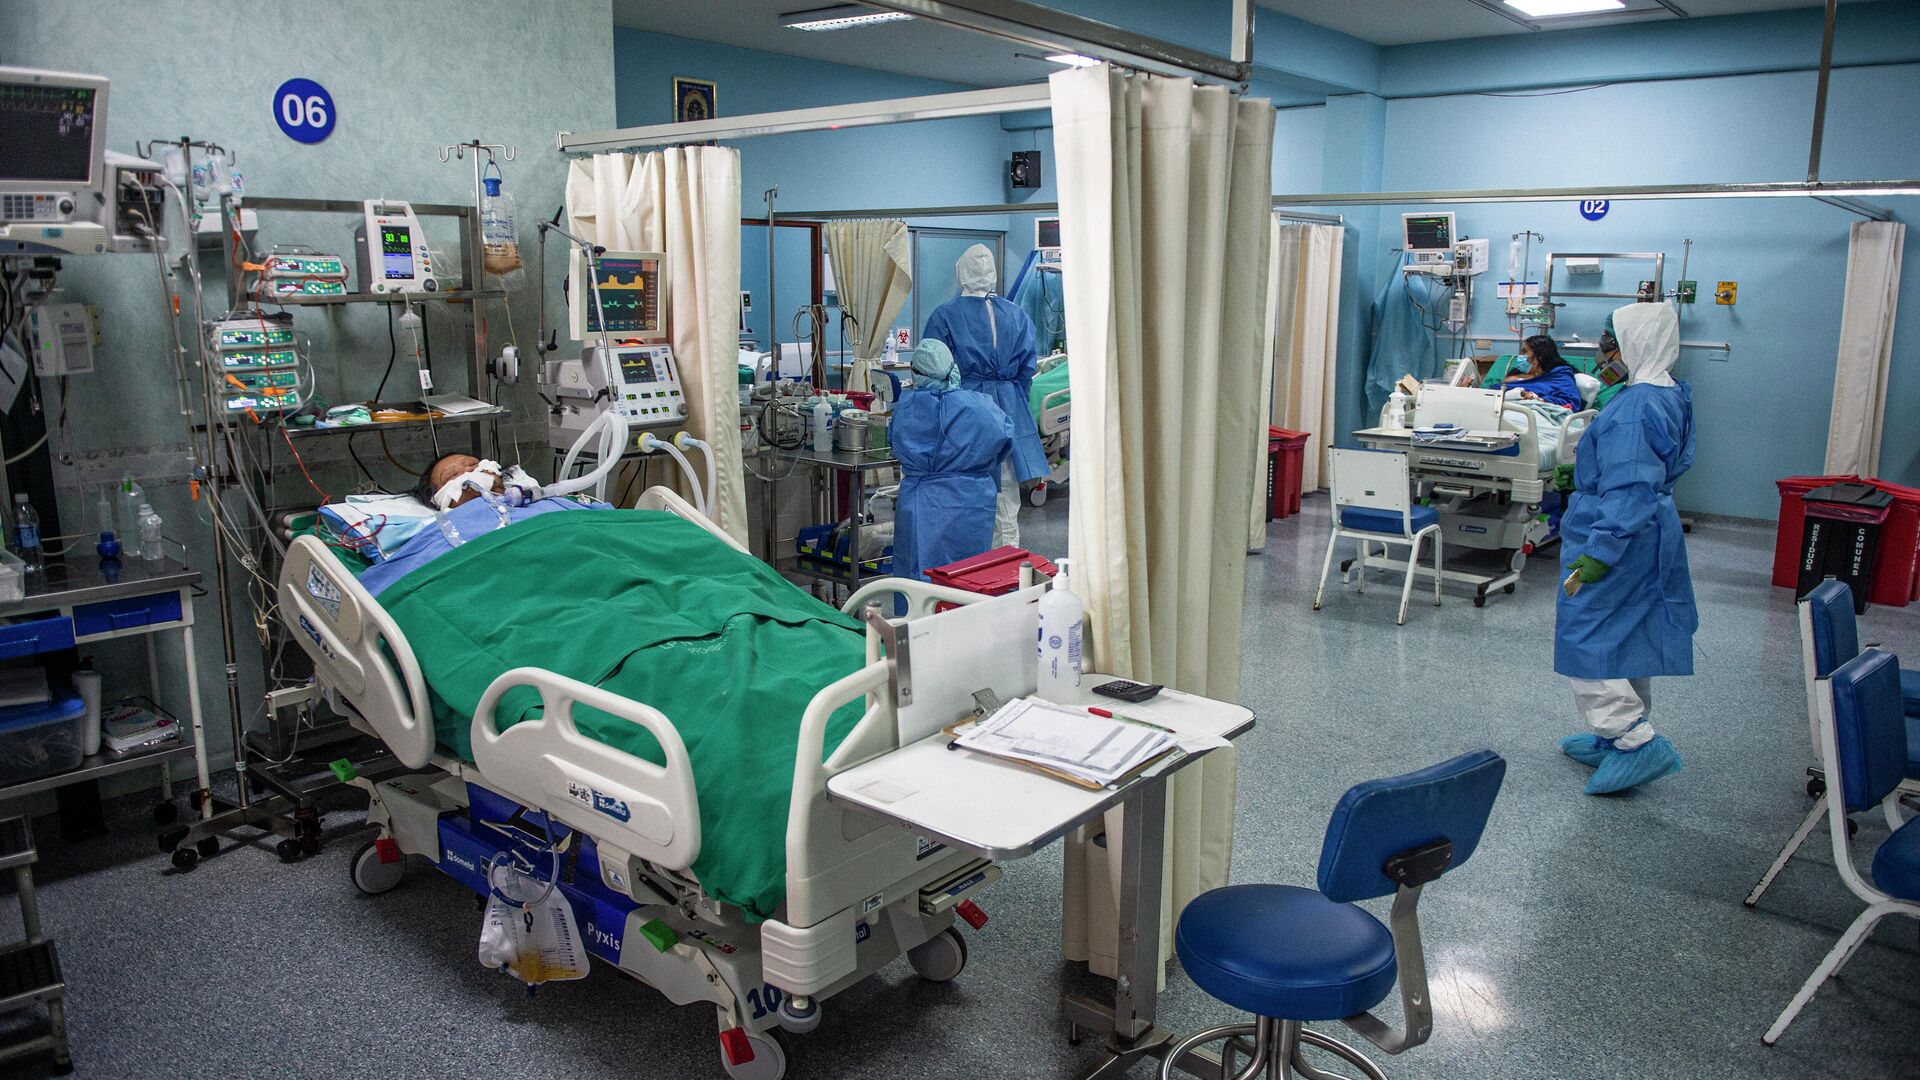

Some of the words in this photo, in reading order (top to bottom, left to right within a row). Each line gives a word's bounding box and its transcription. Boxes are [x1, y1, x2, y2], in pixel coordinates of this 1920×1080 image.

[282, 93, 327, 128] 06
[1583, 200, 1606, 214] 02
[1805, 523, 1820, 571] RESIDUOS
[1851, 528, 1865, 576] COMUNES
[587, 921, 621, 951] Pyxis
[746, 982, 783, 1020] 10
